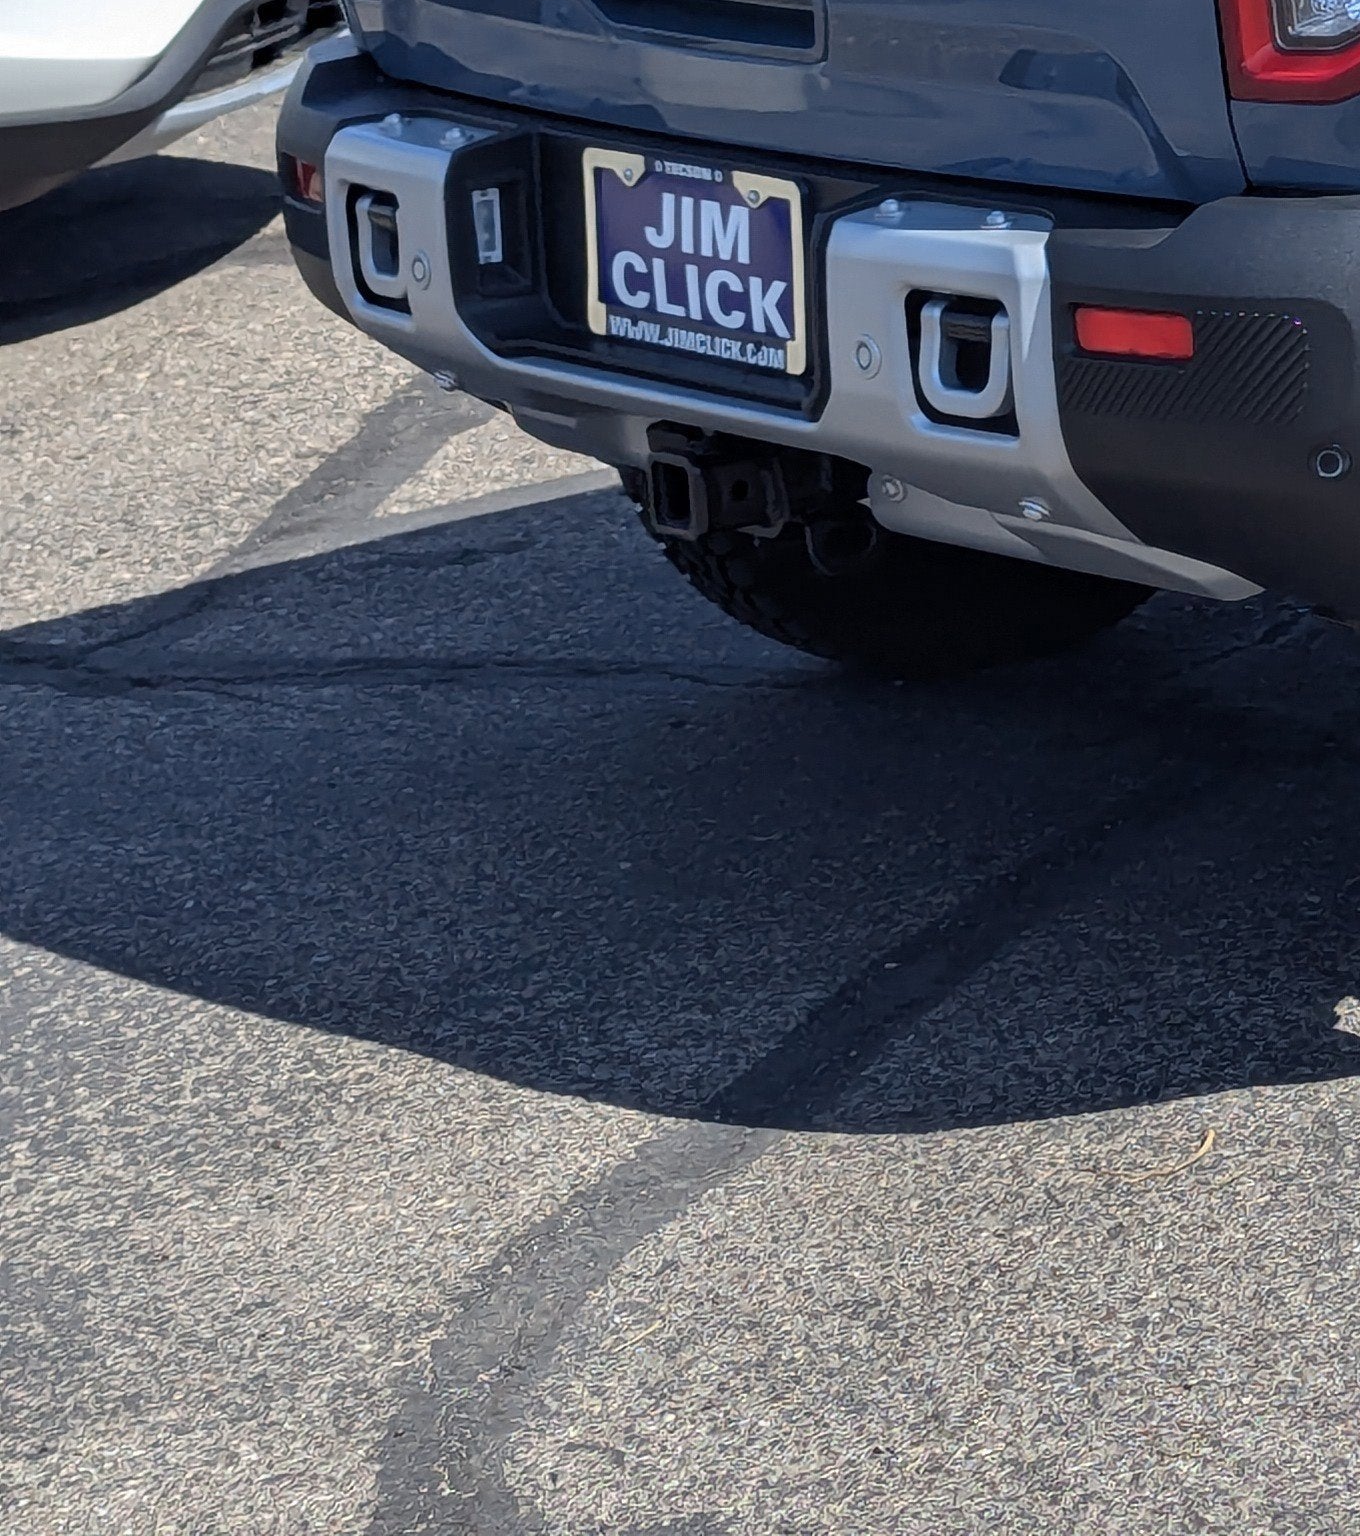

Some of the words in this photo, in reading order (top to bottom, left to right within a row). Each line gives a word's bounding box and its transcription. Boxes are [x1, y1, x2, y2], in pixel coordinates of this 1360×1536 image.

[643, 191, 751, 265] JIM
[611, 250, 792, 339] CLICK
[608, 314, 785, 370] WWW.JIMCLICK.COM
